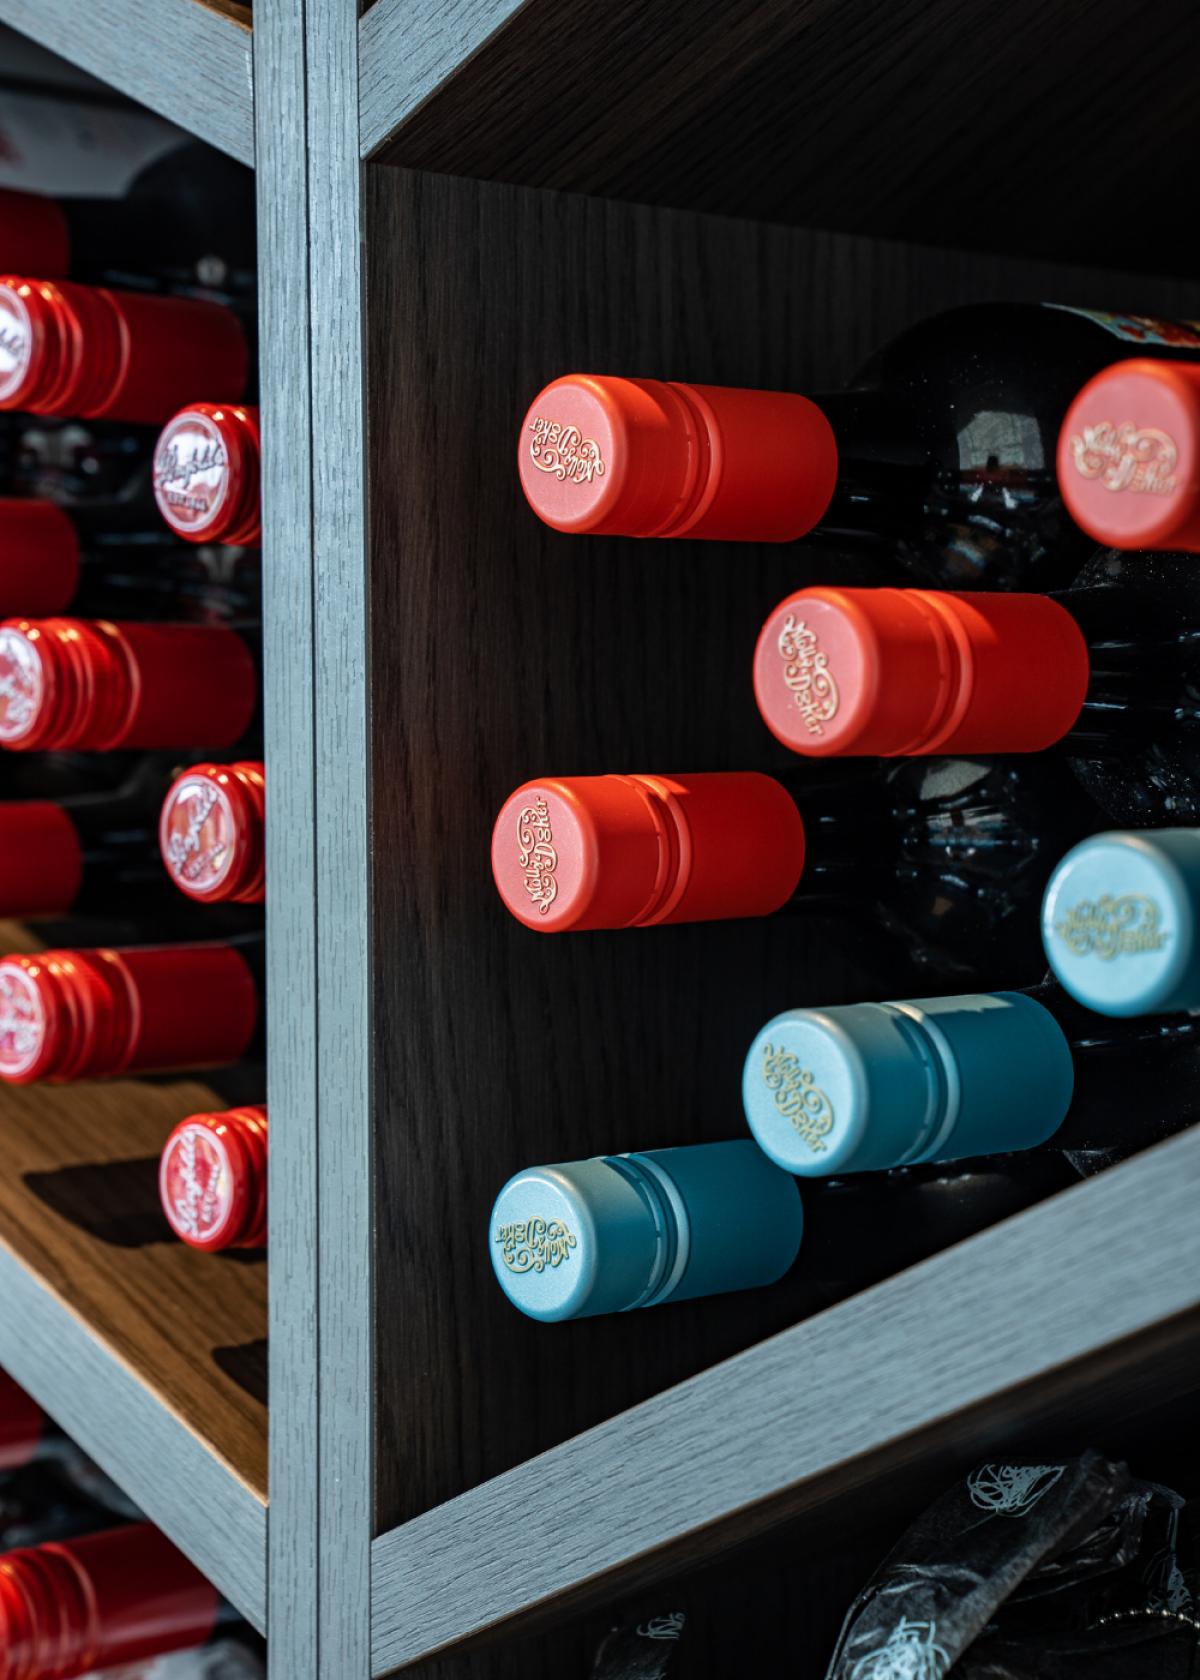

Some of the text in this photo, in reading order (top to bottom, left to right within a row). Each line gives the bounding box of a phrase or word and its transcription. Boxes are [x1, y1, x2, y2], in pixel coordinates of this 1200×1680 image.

[529, 417, 605, 484] Molly Dooker
[778, 613, 839, 736] Molly Dooker
[517, 795, 558, 915] Molly Dooker
[762, 1043, 834, 1152] Molly Dooker
[495, 1216, 577, 1273] Molly Dooker
